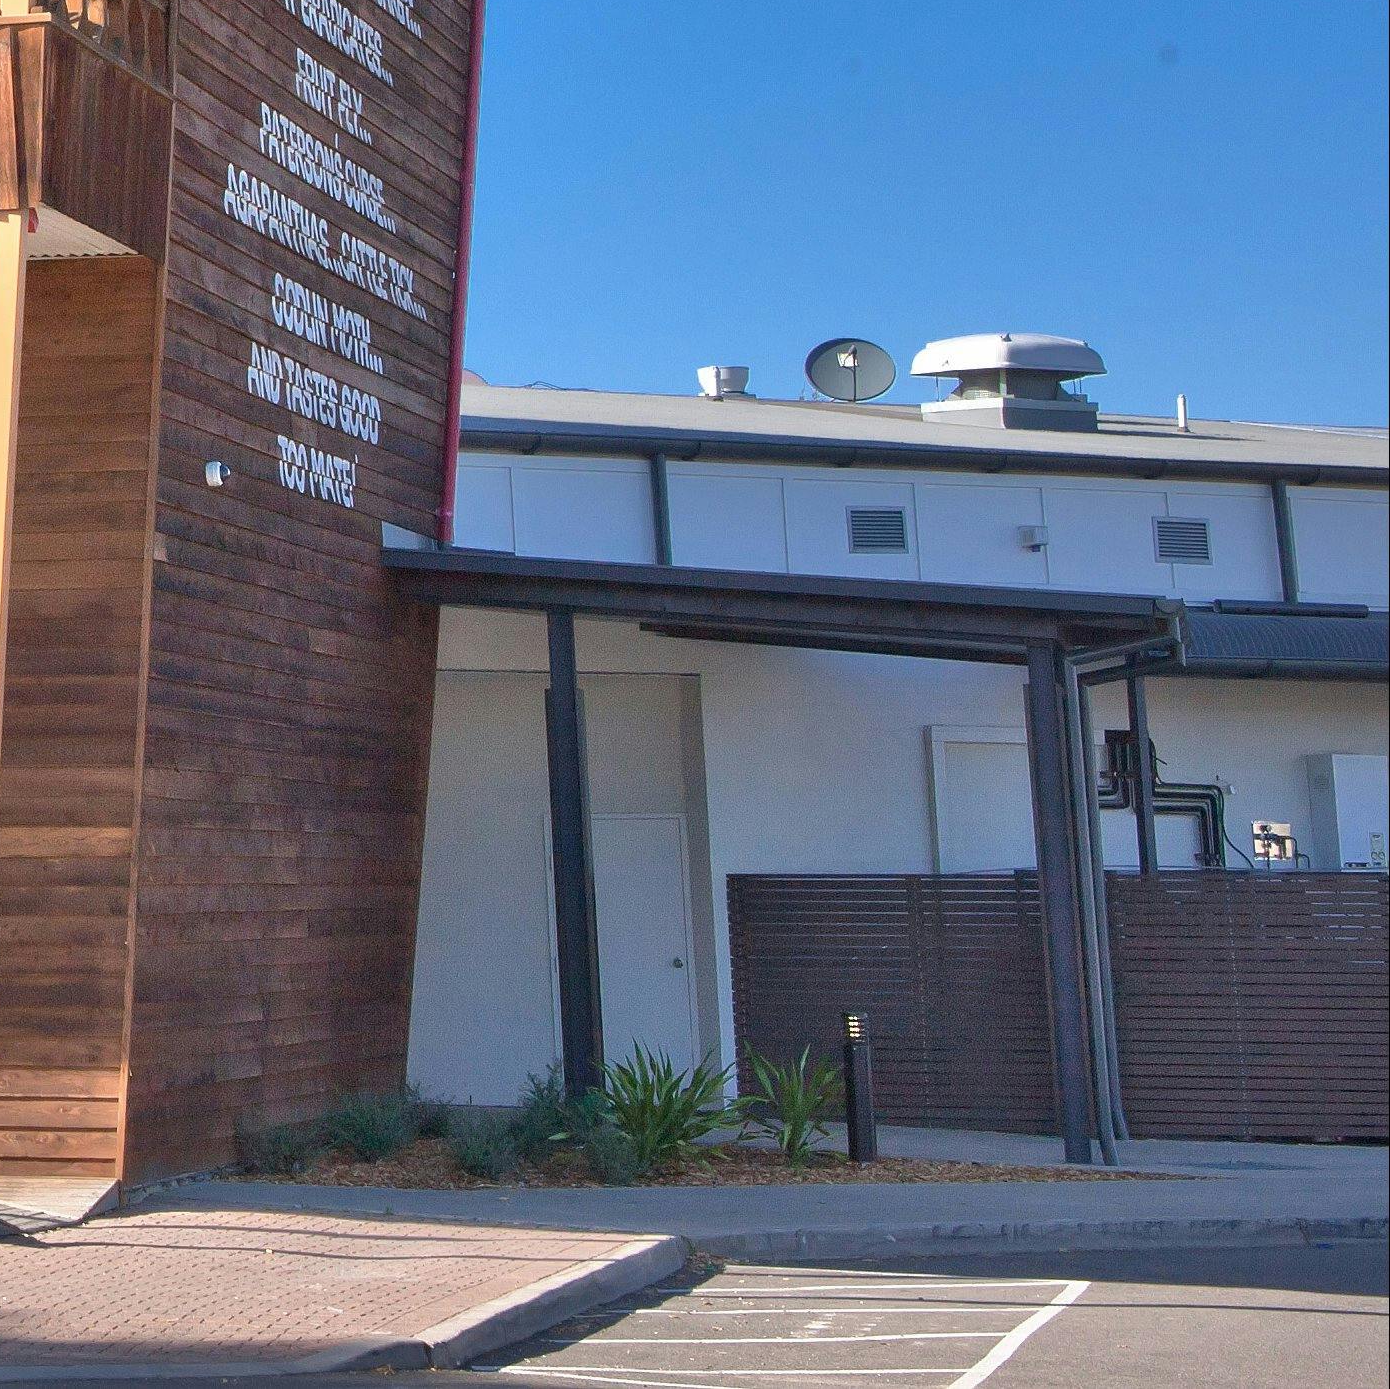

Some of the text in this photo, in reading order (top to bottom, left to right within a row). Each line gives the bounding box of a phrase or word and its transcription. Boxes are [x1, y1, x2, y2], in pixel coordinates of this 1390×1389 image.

[295, 47, 336, 121] FRUIT
[272, 272, 329, 349] CODLIN
[247, 341, 381, 445] AND TASTES GOOD
[277, 434, 308, 494] TOO
